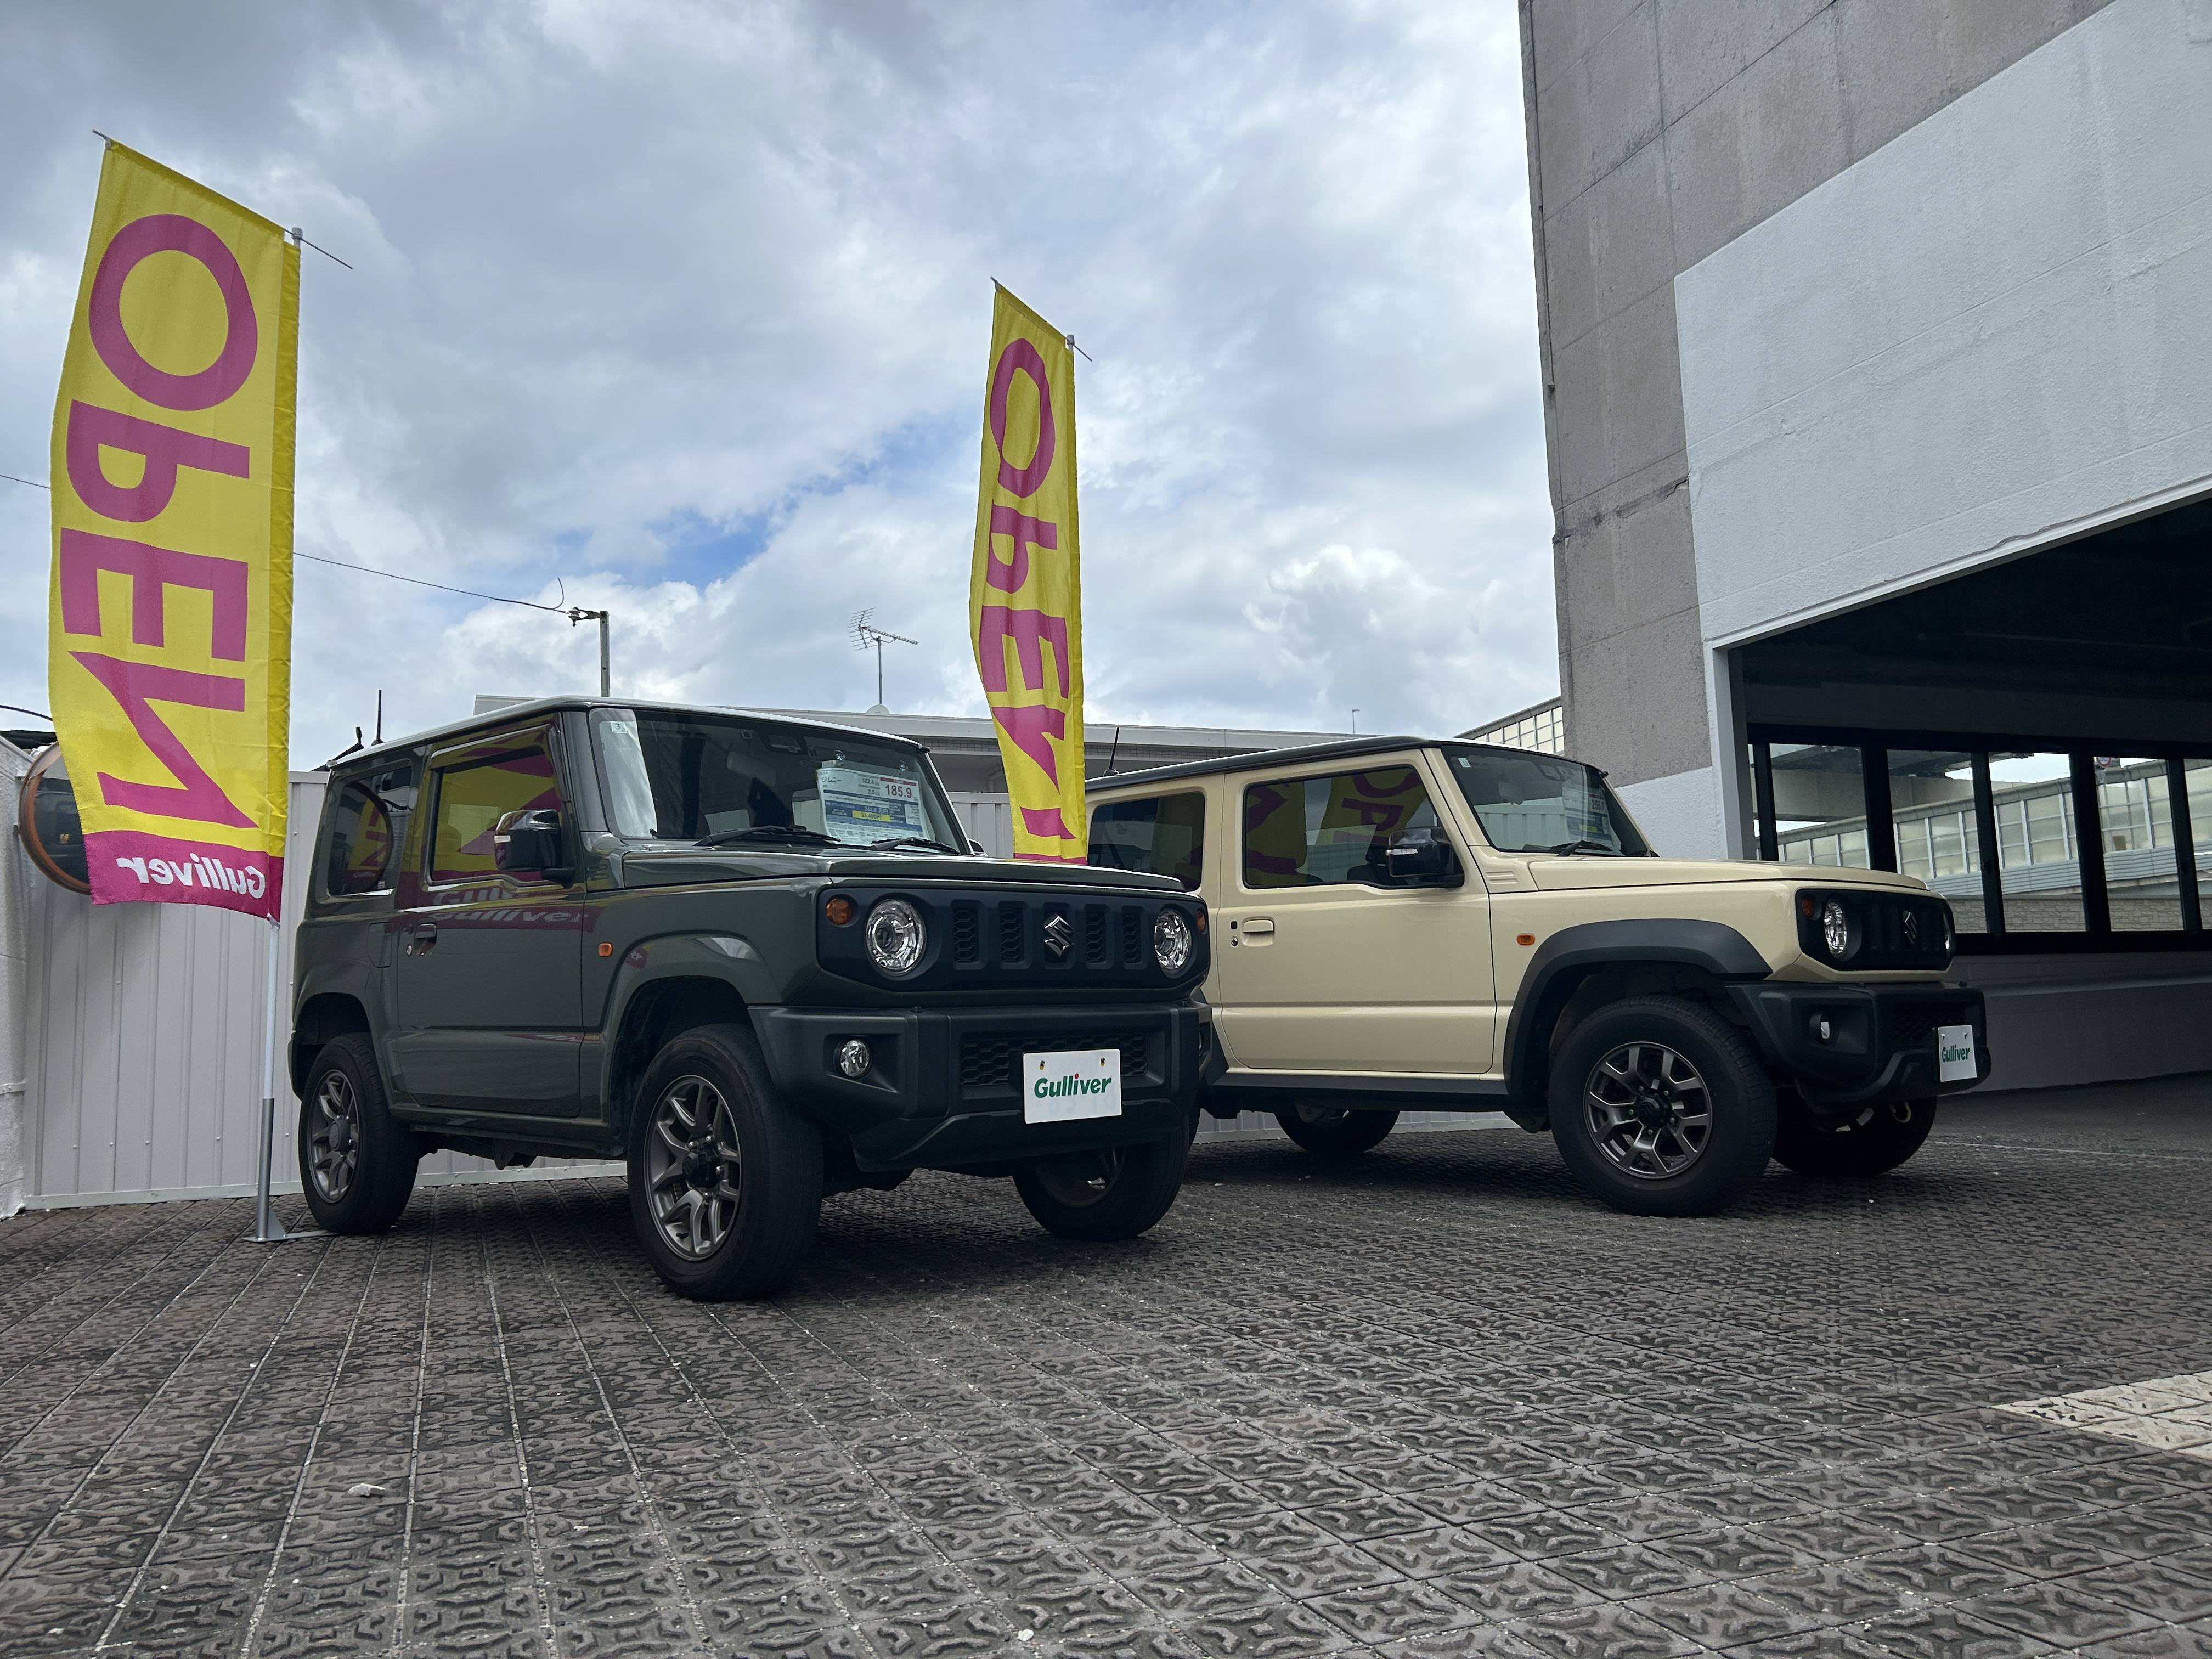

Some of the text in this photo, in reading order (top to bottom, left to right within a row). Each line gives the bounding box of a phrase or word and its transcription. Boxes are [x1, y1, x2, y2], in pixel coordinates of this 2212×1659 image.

[885, 784, 912, 798] 185.9
[1942, 1044, 1971, 1063] Gulliver
[1034, 1073, 1112, 1098] Gulliver
